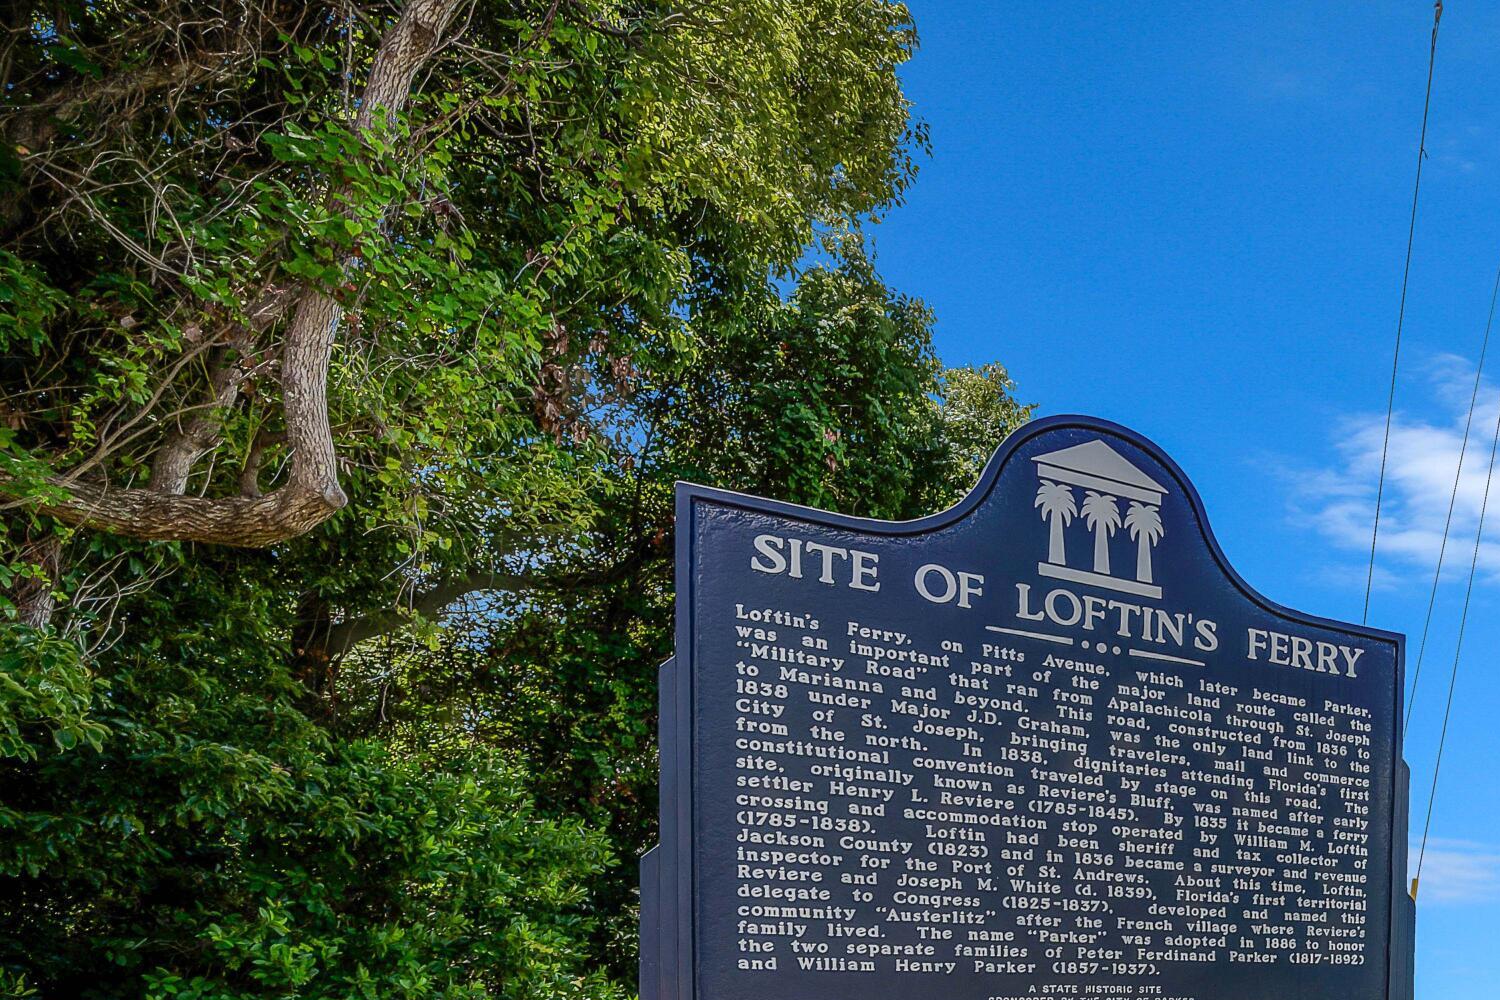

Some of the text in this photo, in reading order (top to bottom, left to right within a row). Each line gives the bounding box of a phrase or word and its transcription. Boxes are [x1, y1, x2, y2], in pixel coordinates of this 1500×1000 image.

[750, 534, 1365, 678] SITE OF LOFTIN'S FERRY
[735, 625, 1372, 732] was an important part of the major land route called the
[847, 621, 912, 645] Ferry,
[940, 640, 963, 653] on
[982, 643, 1025, 662] Pitts
[1041, 653, 1110, 677] Avenue,
[1135, 671, 1184, 688] which
[1199, 679, 1238, 696] later
[1252, 687, 1306, 707] became
[1324, 699, 1372, 719] Parker,
[735, 661, 1370, 760] to Marianna and beyond. This road, constructed from 1836 to
[735, 698, 1370, 788] City of St. Joseph, bringing travelers, mail and commerce
[736, 678, 1370, 774] 1838 under Major J.D. Graham, was the only land link to the
[735, 738, 1369, 815] constitutional convention traveled by stage on this road. The
[736, 775, 1369, 844] settler Henry L. Reviere (1785-1845). By 1835 it became a ferry
[736, 794, 1368, 857] crossing and accommodation stop operated by William M. Loftin
[736, 828, 1367, 884] Jackson County (1823) and in 1836 became a surveyor and revenue
[737, 846, 1367, 899] inspector for the Port of St. Andrews. About this time, Loftin,
[737, 883, 1366, 925] delegate to Congress (1825-1837), developed and named this
[737, 938, 1365, 965] the two separate families of Peter Ferdinand Parker (1817-1892)
[737, 956, 1160, 975] and William Henry Parker (1857-1937).
[1028, 984, 1162, 994] A STATE HISTORIC SITE
